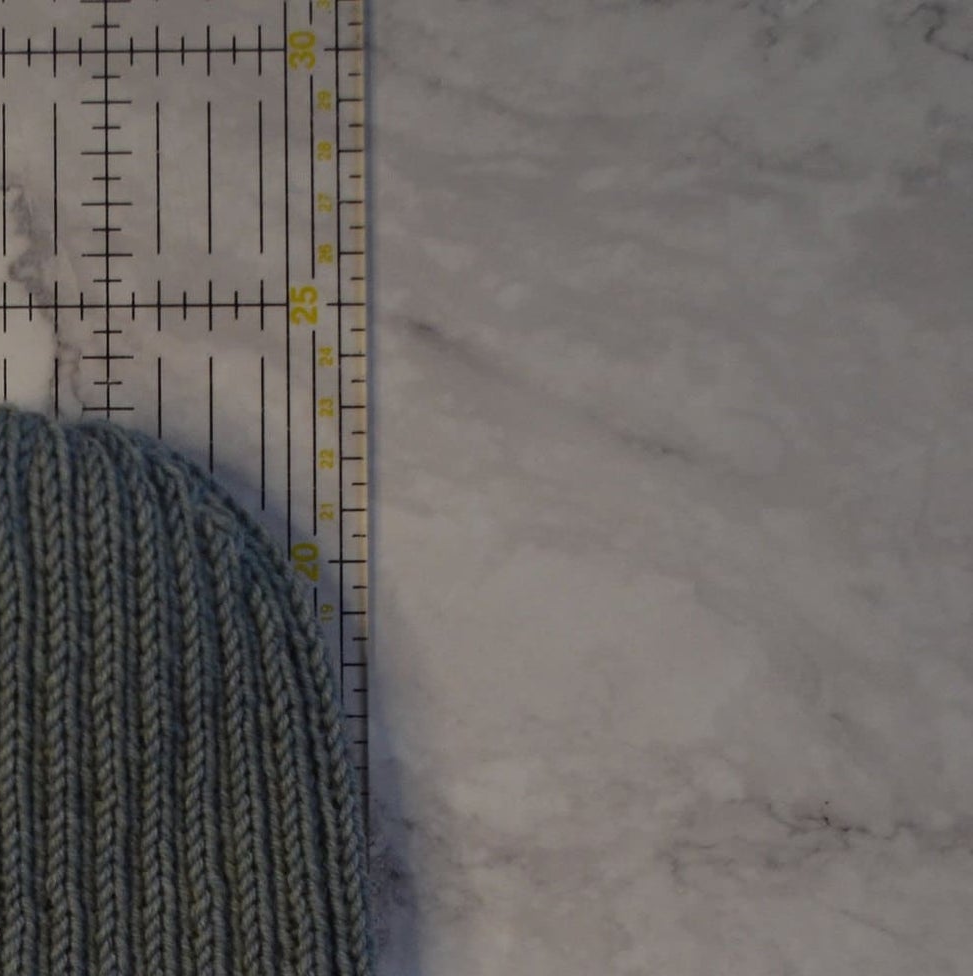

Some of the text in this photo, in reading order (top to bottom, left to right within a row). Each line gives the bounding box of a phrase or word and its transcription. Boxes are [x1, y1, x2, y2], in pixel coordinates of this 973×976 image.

[288, 30, 317, 69] 30
[317, 90, 332, 110] 29
[317, 141, 332, 160] 28
[318, 193, 333, 212] 27
[318, 243, 333, 264] 26
[289, 285, 319, 326] 25
[319, 346, 334, 367] 24
[319, 397, 334, 418] 23
[319, 449, 334, 470] 22
[319, 502, 334, 521] 21
[291, 542, 319, 583] 20
[320, 603, 334, 622] 19
